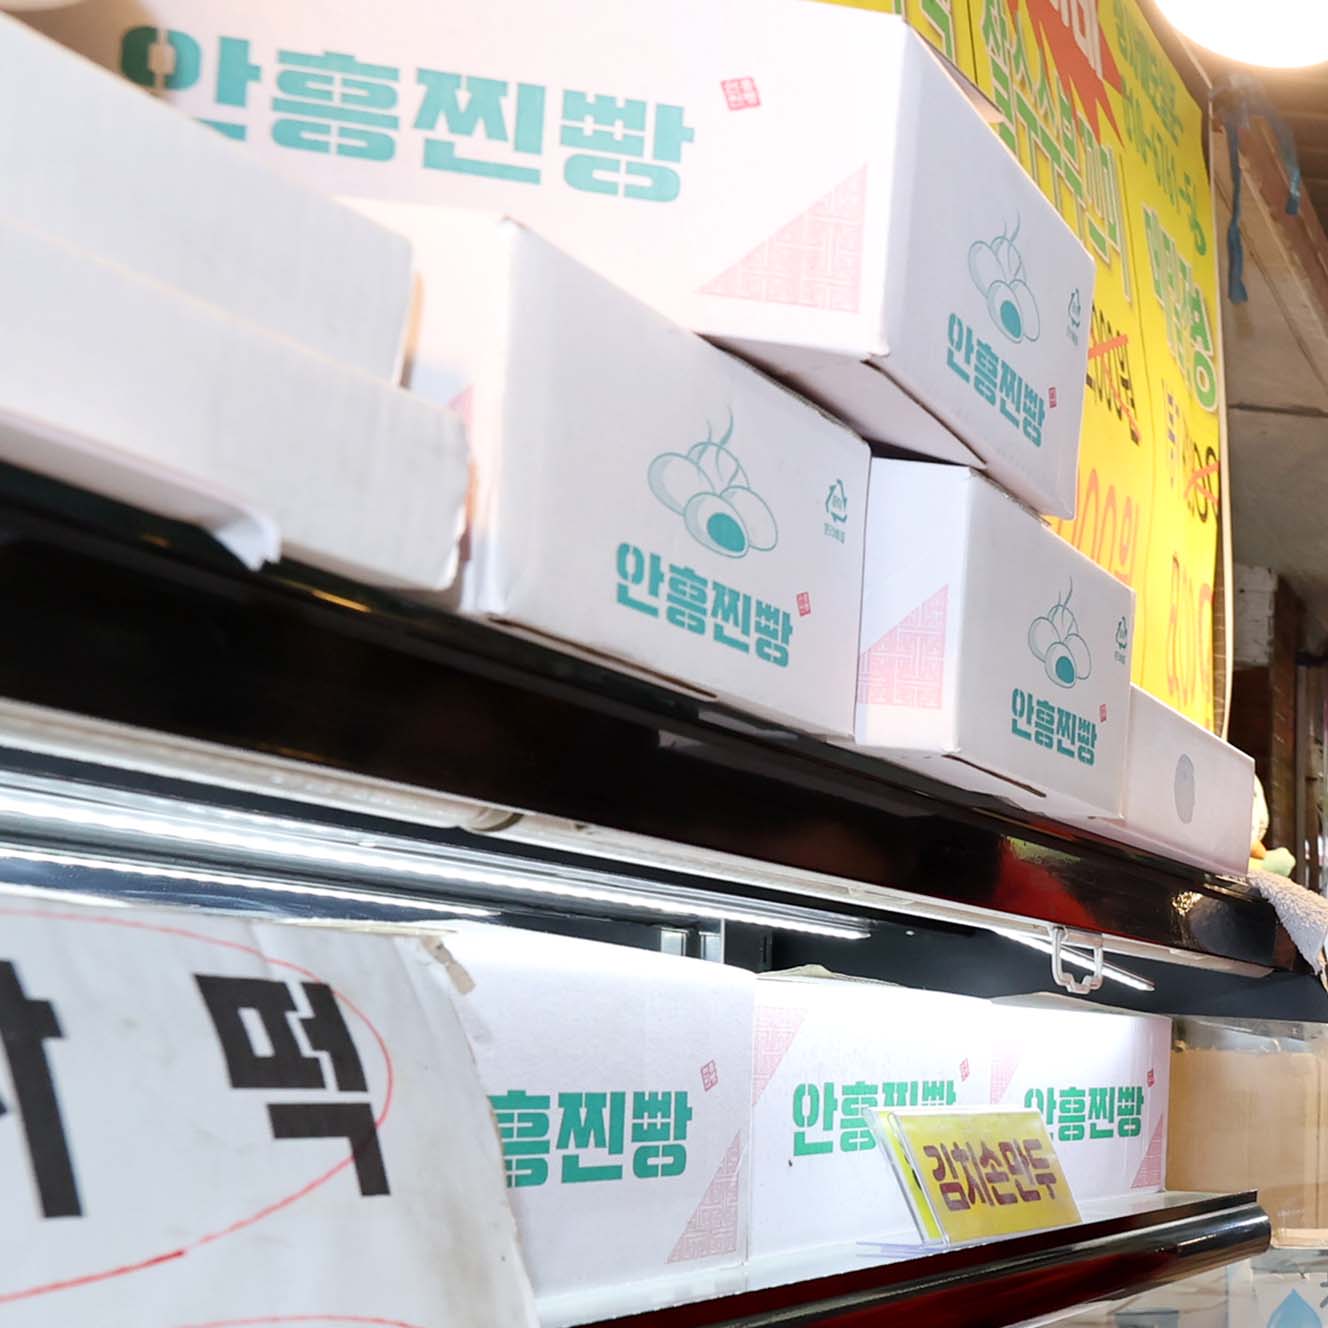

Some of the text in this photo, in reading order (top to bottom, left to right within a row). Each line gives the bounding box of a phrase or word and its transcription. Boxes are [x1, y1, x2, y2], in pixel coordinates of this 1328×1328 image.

[120, 25, 695, 203] 안흥찐빵
[947, 312, 1046, 450] 안흥찐빵
[616, 542, 794, 669] 안흥찐빵
[1012, 688, 1098, 768] 안흥찐빵
[490, 1089, 693, 1189] 흥찐빵
[923, 1138, 1058, 1213] 김치손만두
